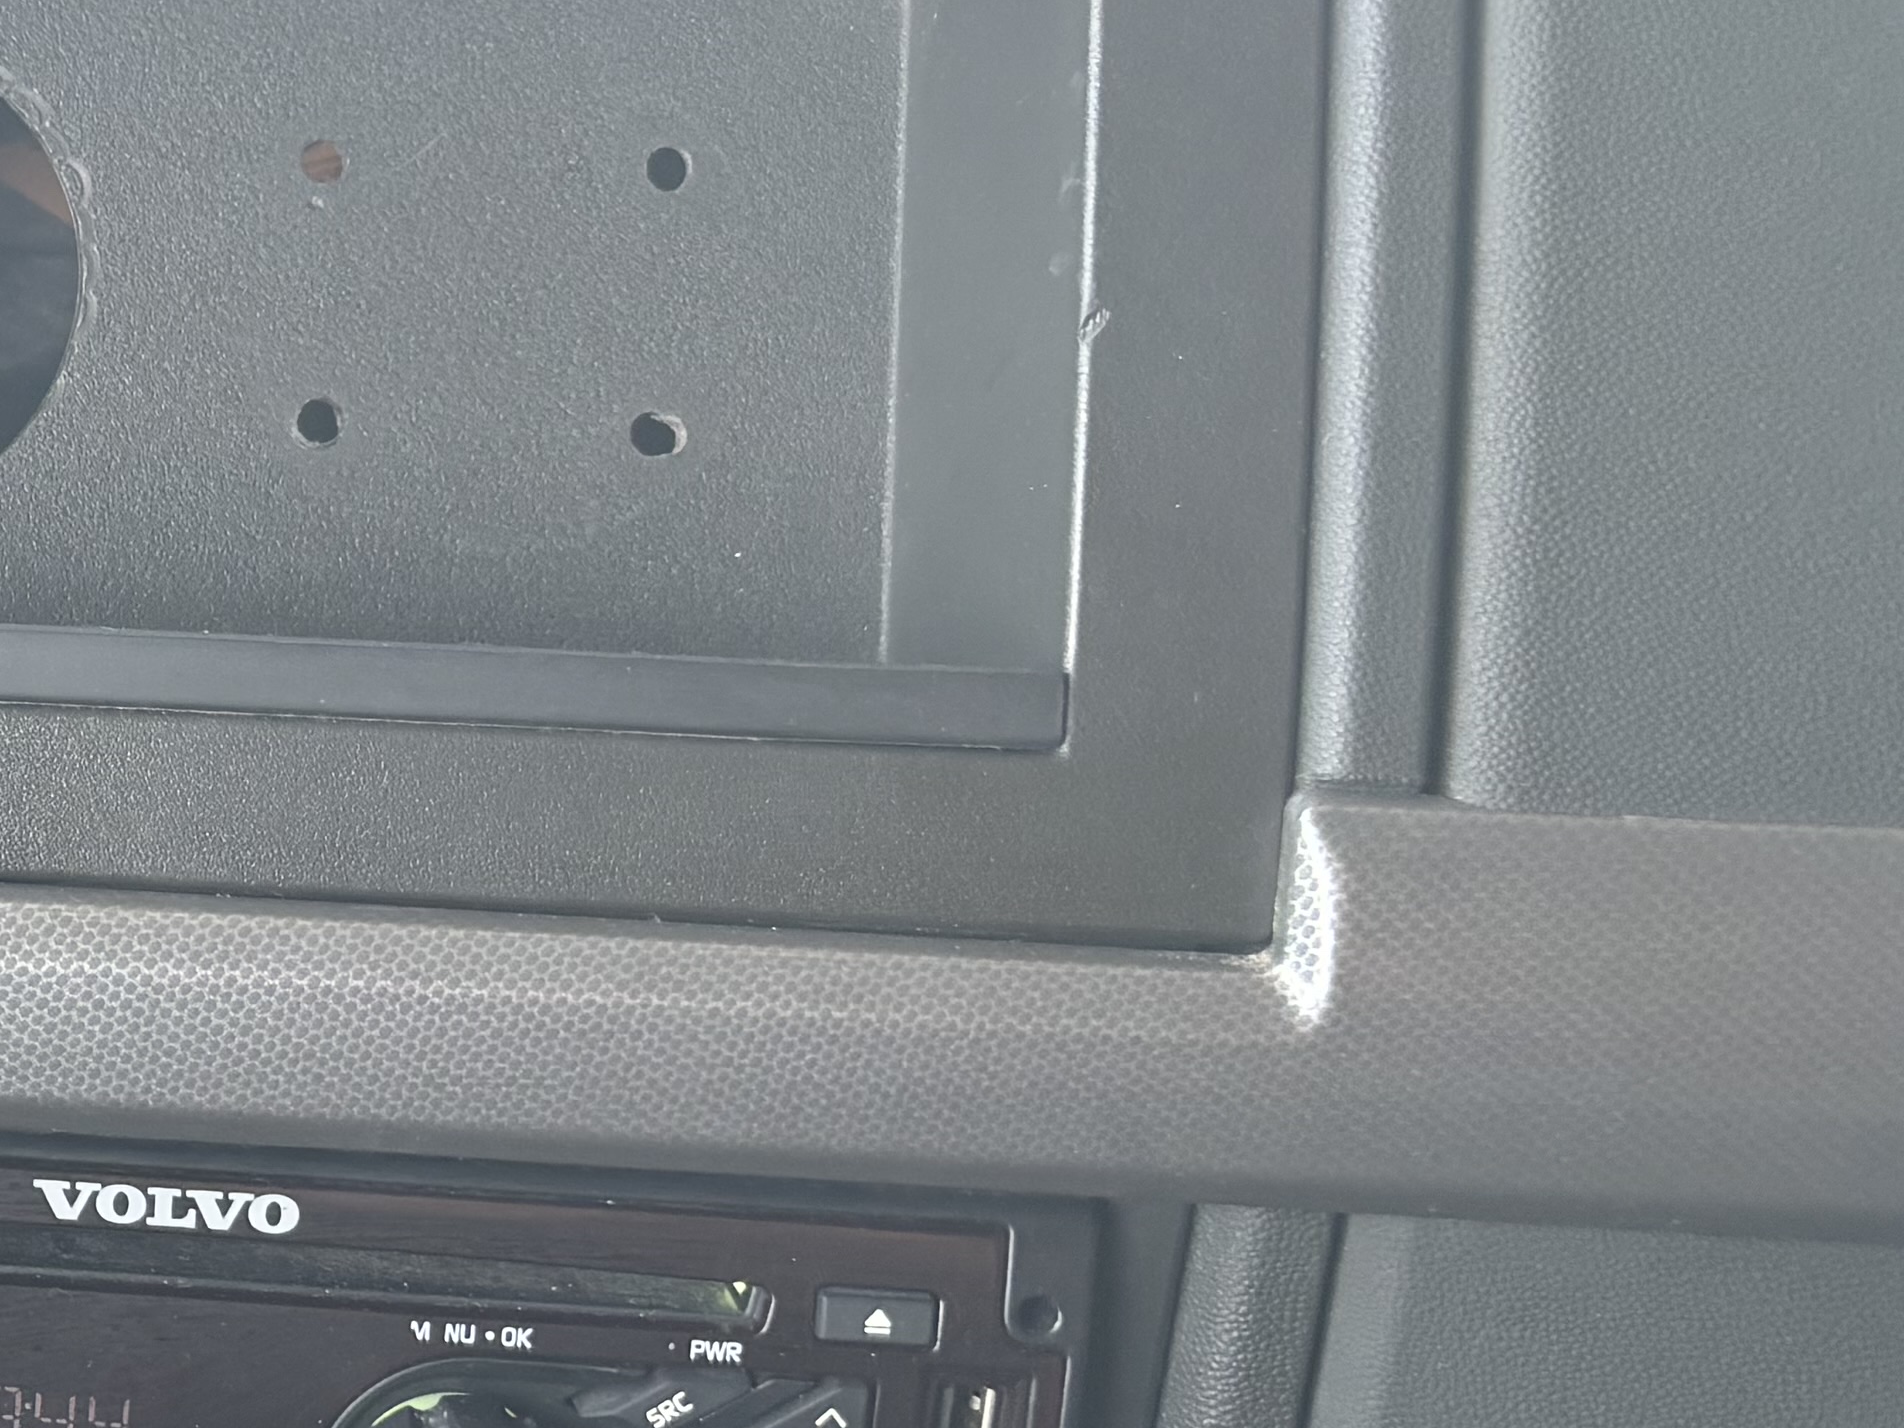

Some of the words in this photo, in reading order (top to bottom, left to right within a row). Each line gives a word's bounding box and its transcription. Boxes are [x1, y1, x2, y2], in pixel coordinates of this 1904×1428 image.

[32, 1178, 300, 1234] VOLVO
[410, 1320, 476, 1345] MNU
[500, 1326, 534, 1349] OK
[689, 1339, 743, 1363] PWR
